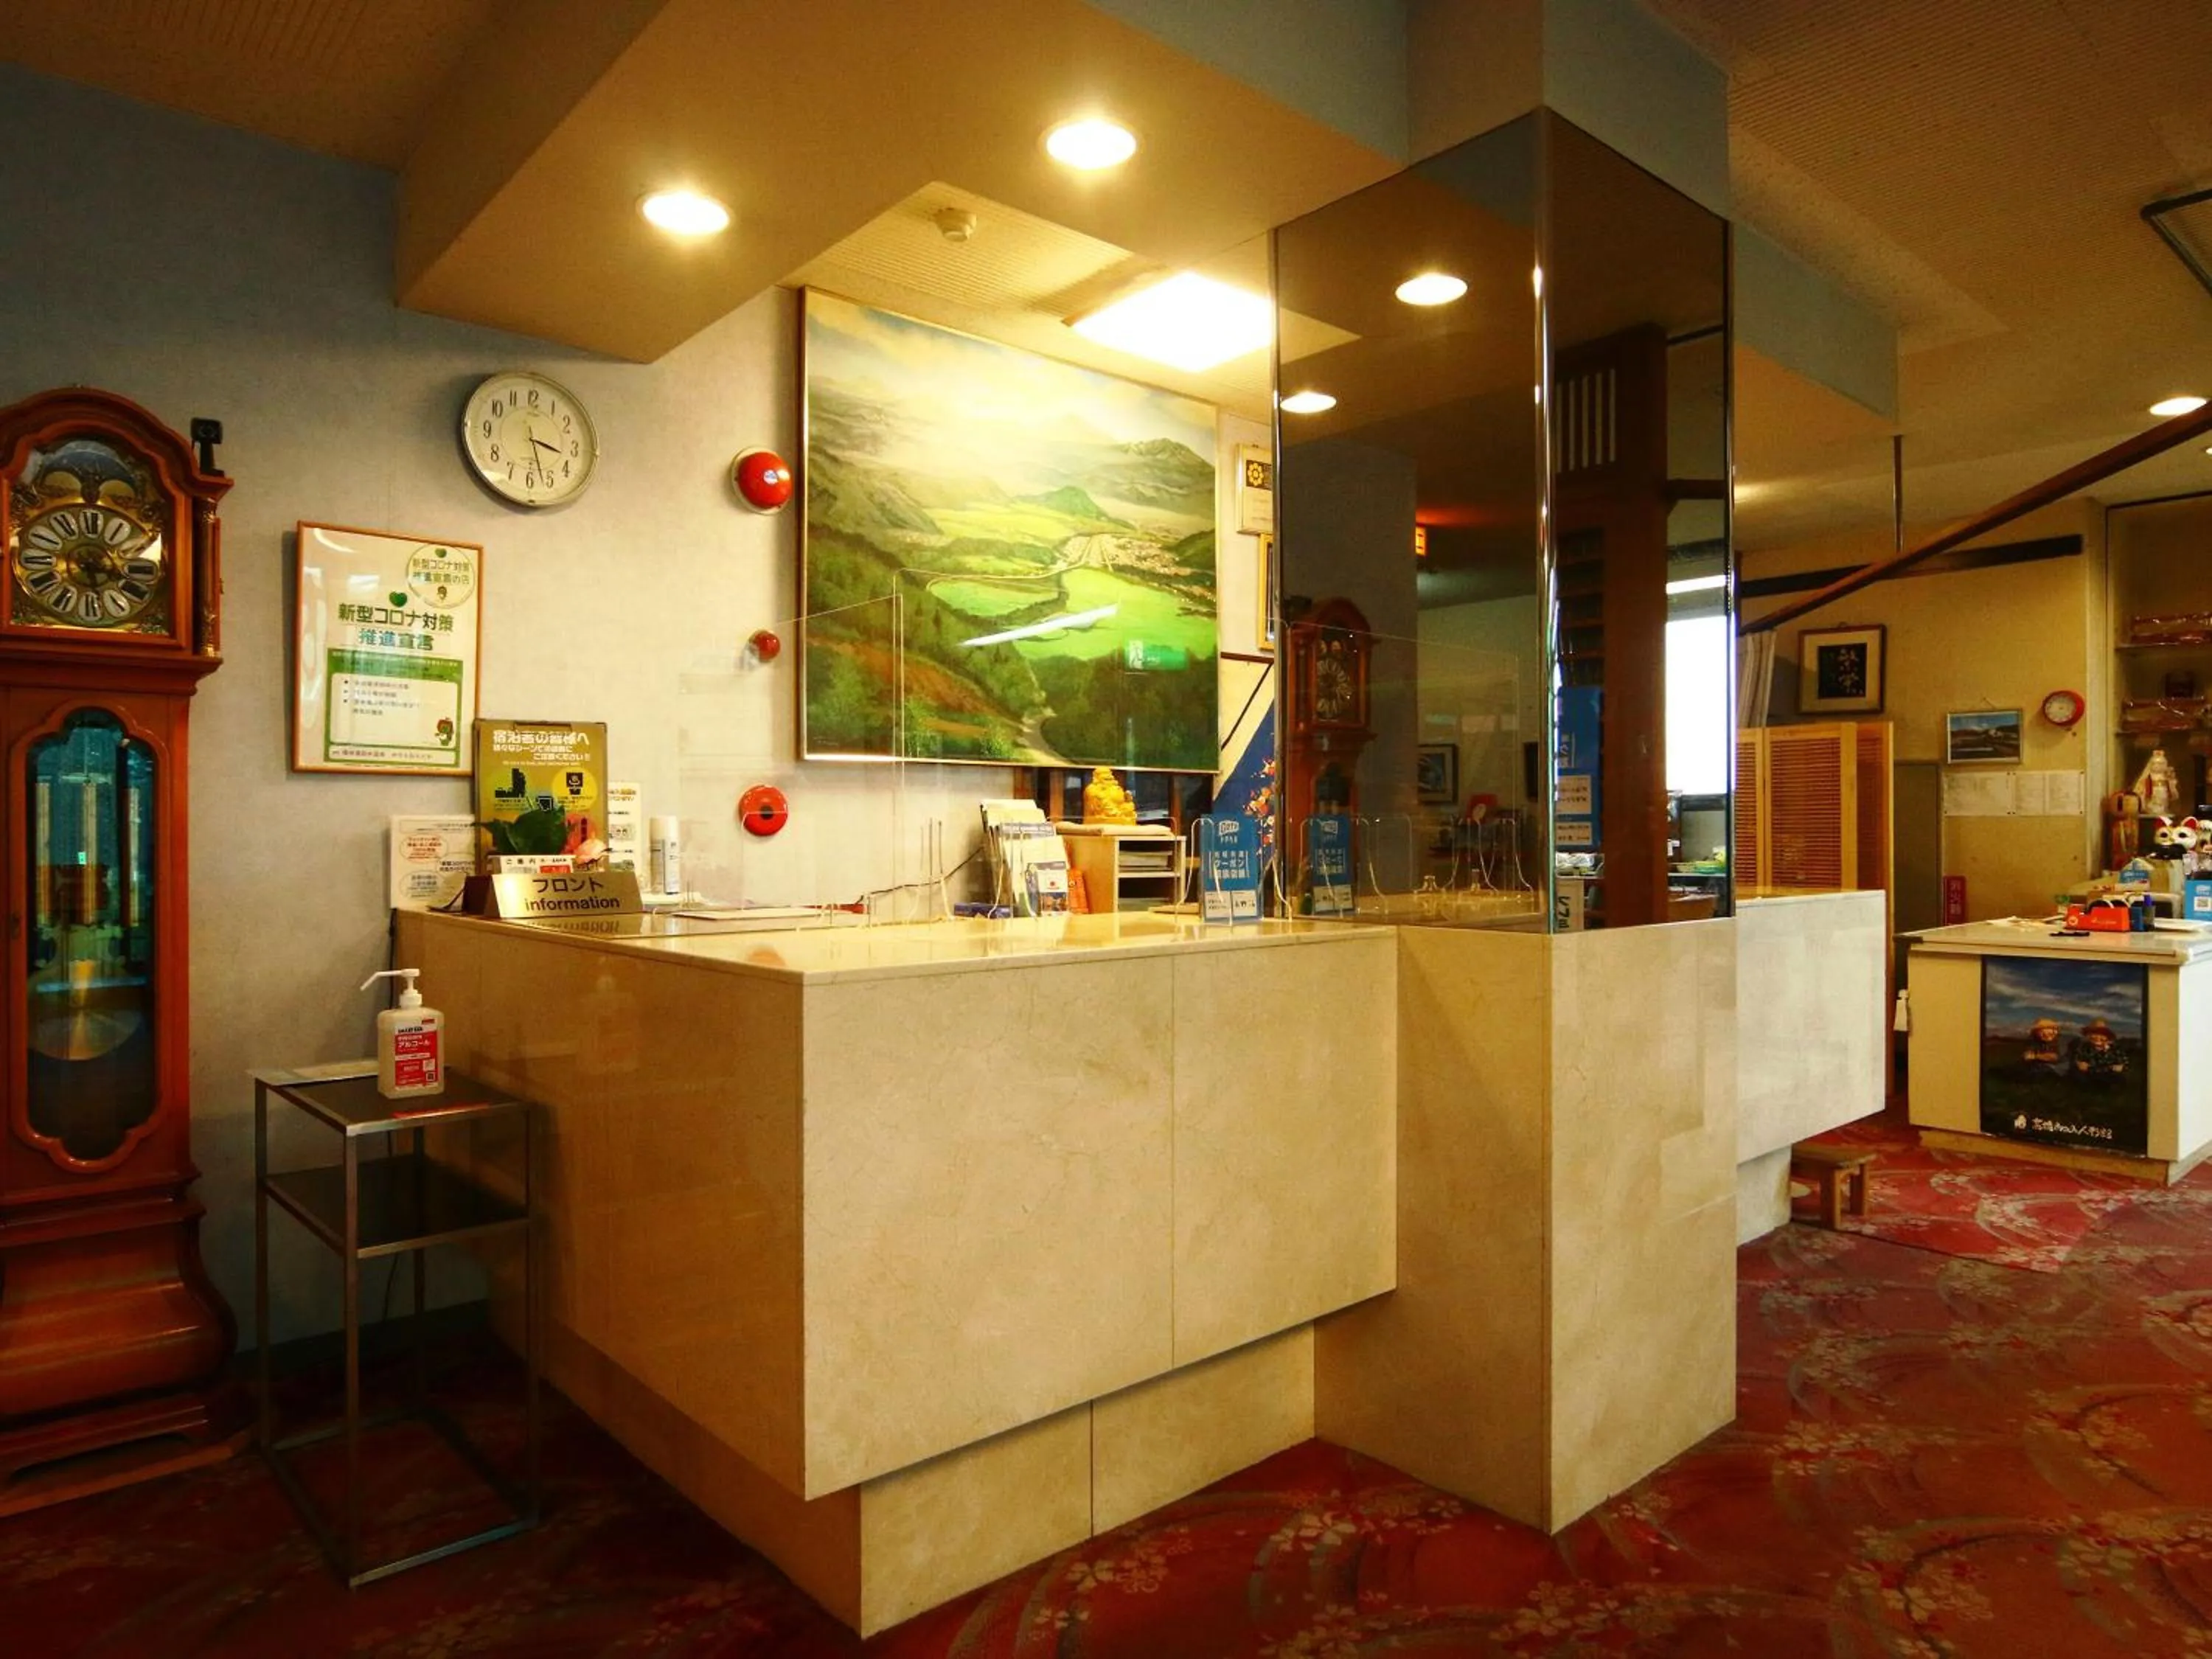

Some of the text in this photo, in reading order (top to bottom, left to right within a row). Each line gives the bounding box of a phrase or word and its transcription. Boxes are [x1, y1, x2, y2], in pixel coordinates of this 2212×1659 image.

[509, 389, 517, 407] 11
[527, 389, 539, 409] 12
[491, 400, 504, 417] 10
[551, 400, 555, 416] 1
[483, 420, 492, 439] 9
[563, 415, 571, 434] 2
[490, 444, 499, 462] 8
[570, 440, 579, 457] 3
[507, 462, 515, 480] 7
[562, 459, 571, 478] 4
[526, 472, 534, 489] 6
[546, 470, 554, 488] 5
[338, 602, 454, 633] 新型コロナ対策
[358, 627, 434, 651] 推進宣言
[532, 877, 603, 893] フロント
[525, 895, 620, 912] information
